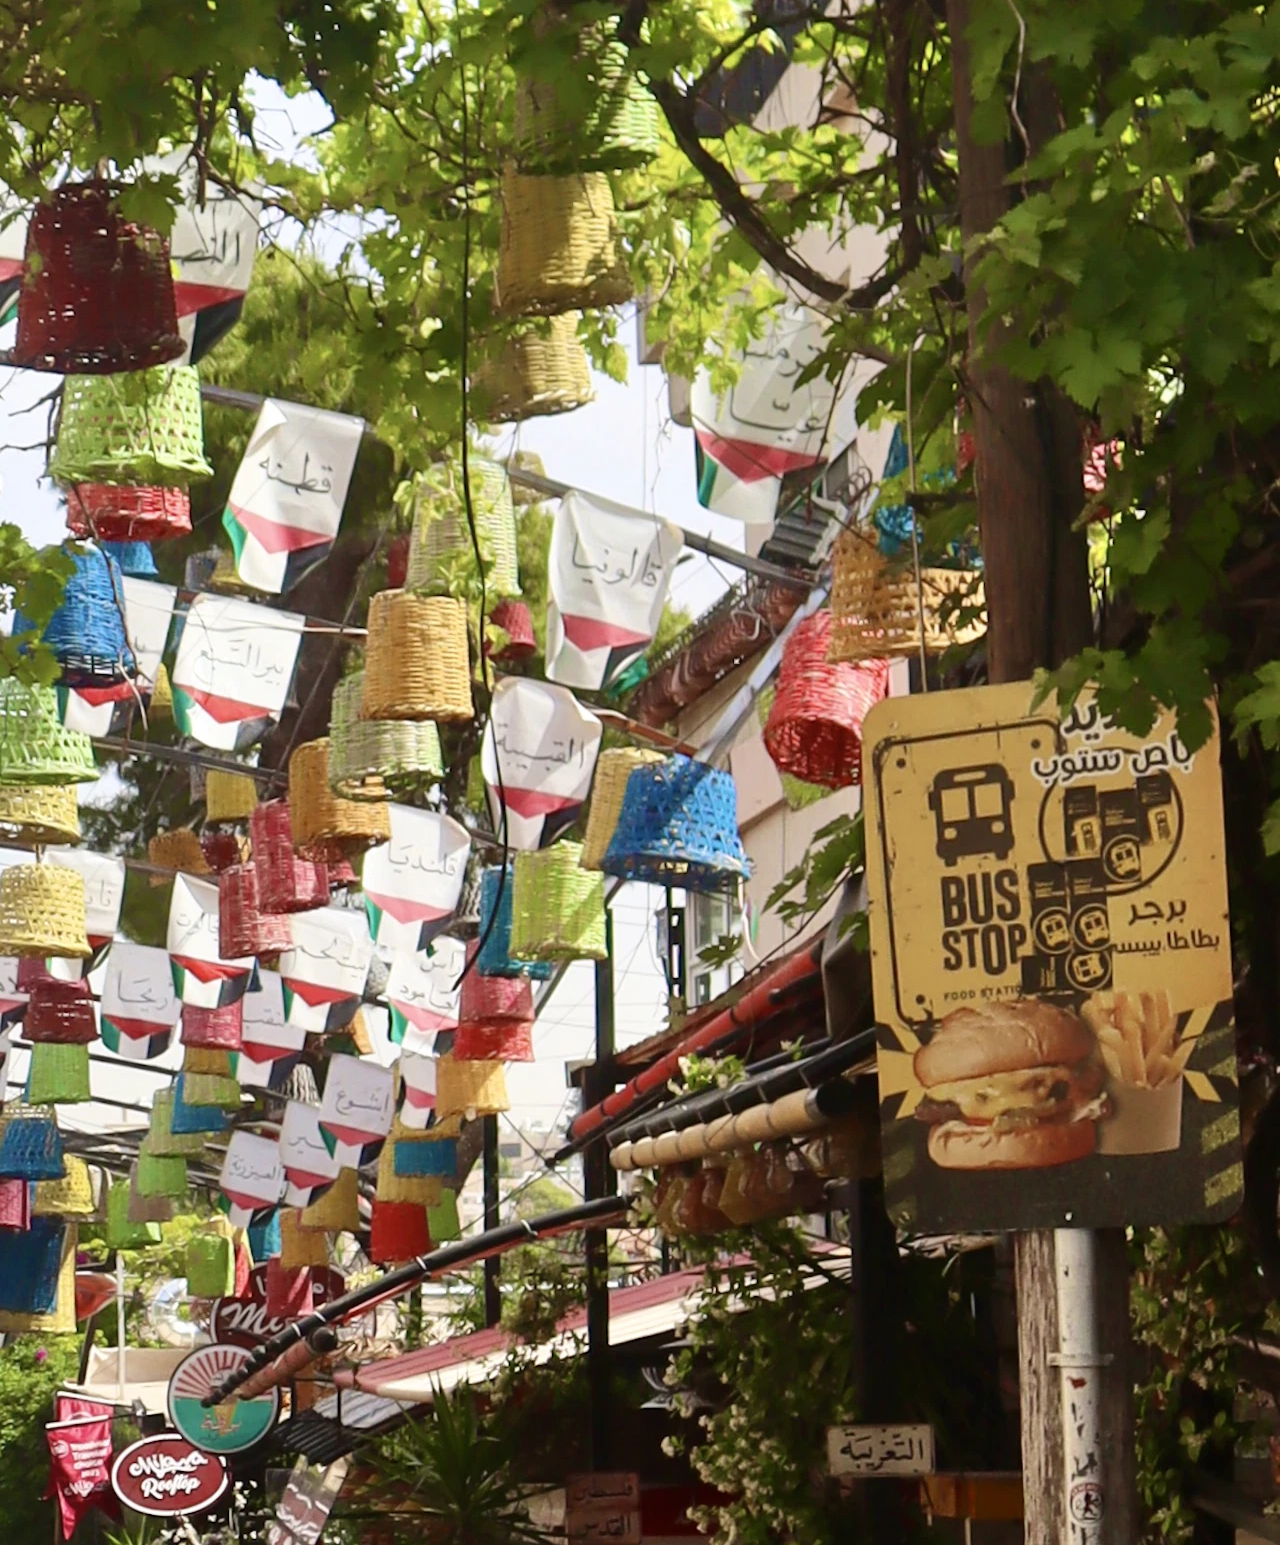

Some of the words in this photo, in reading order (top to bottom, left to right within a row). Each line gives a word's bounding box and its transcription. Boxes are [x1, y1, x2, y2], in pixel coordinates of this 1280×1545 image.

[1035, 748, 1120, 783] ستوب
[1133, 735, 1191, 773] باص
[940, 868, 1022, 929] BUS
[1128, 898, 1187, 926] برجر
[941, 922, 1028, 976] STOP
[943, 990, 976, 1002] FOOD
[979, 985, 1023, 999] STATIO
[128, 1449, 209, 1479] Mijana
[141, 1474, 202, 1500] Rooftop
